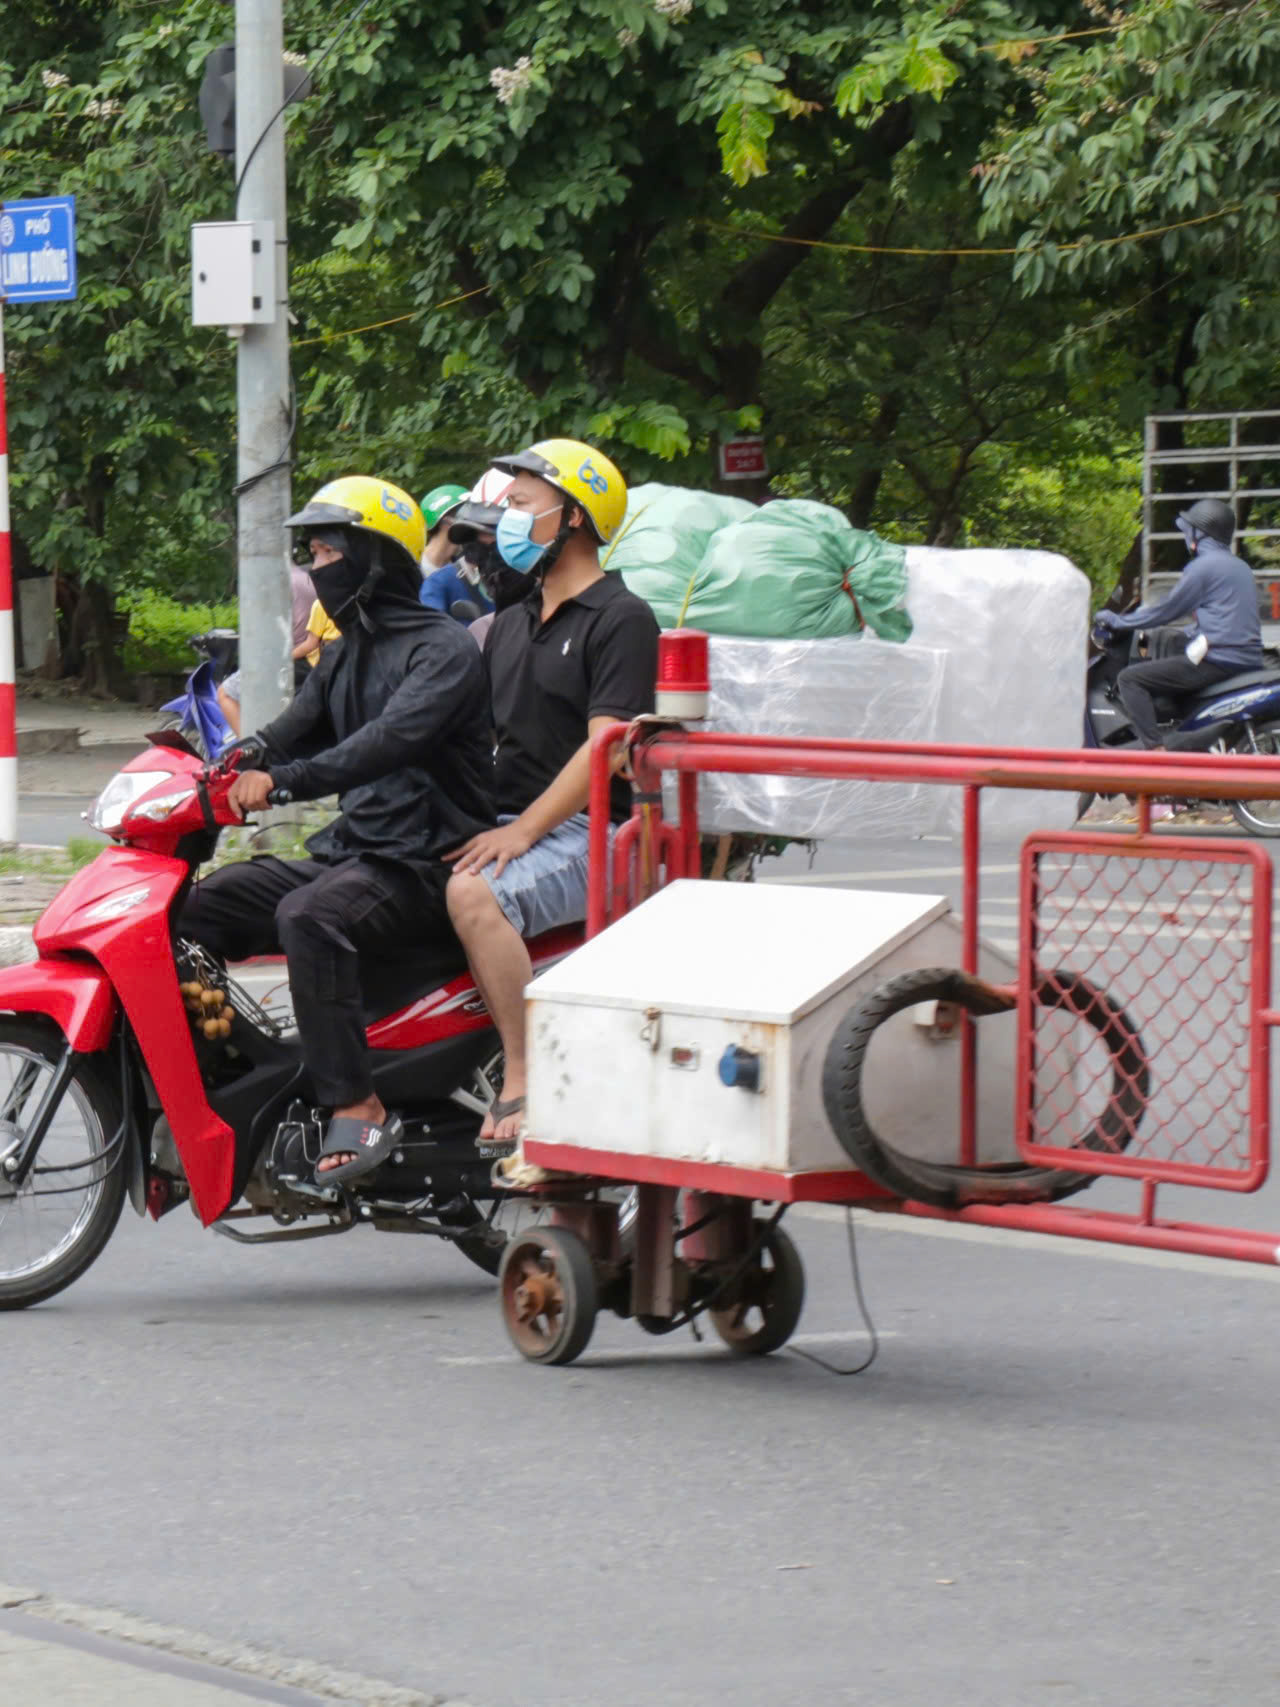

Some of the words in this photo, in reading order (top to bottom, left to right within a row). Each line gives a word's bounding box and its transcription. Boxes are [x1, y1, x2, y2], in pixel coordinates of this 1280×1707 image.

[24, 209, 52, 236] PHỐ
[578, 458, 609, 495] be
[381, 488, 412, 521] be
